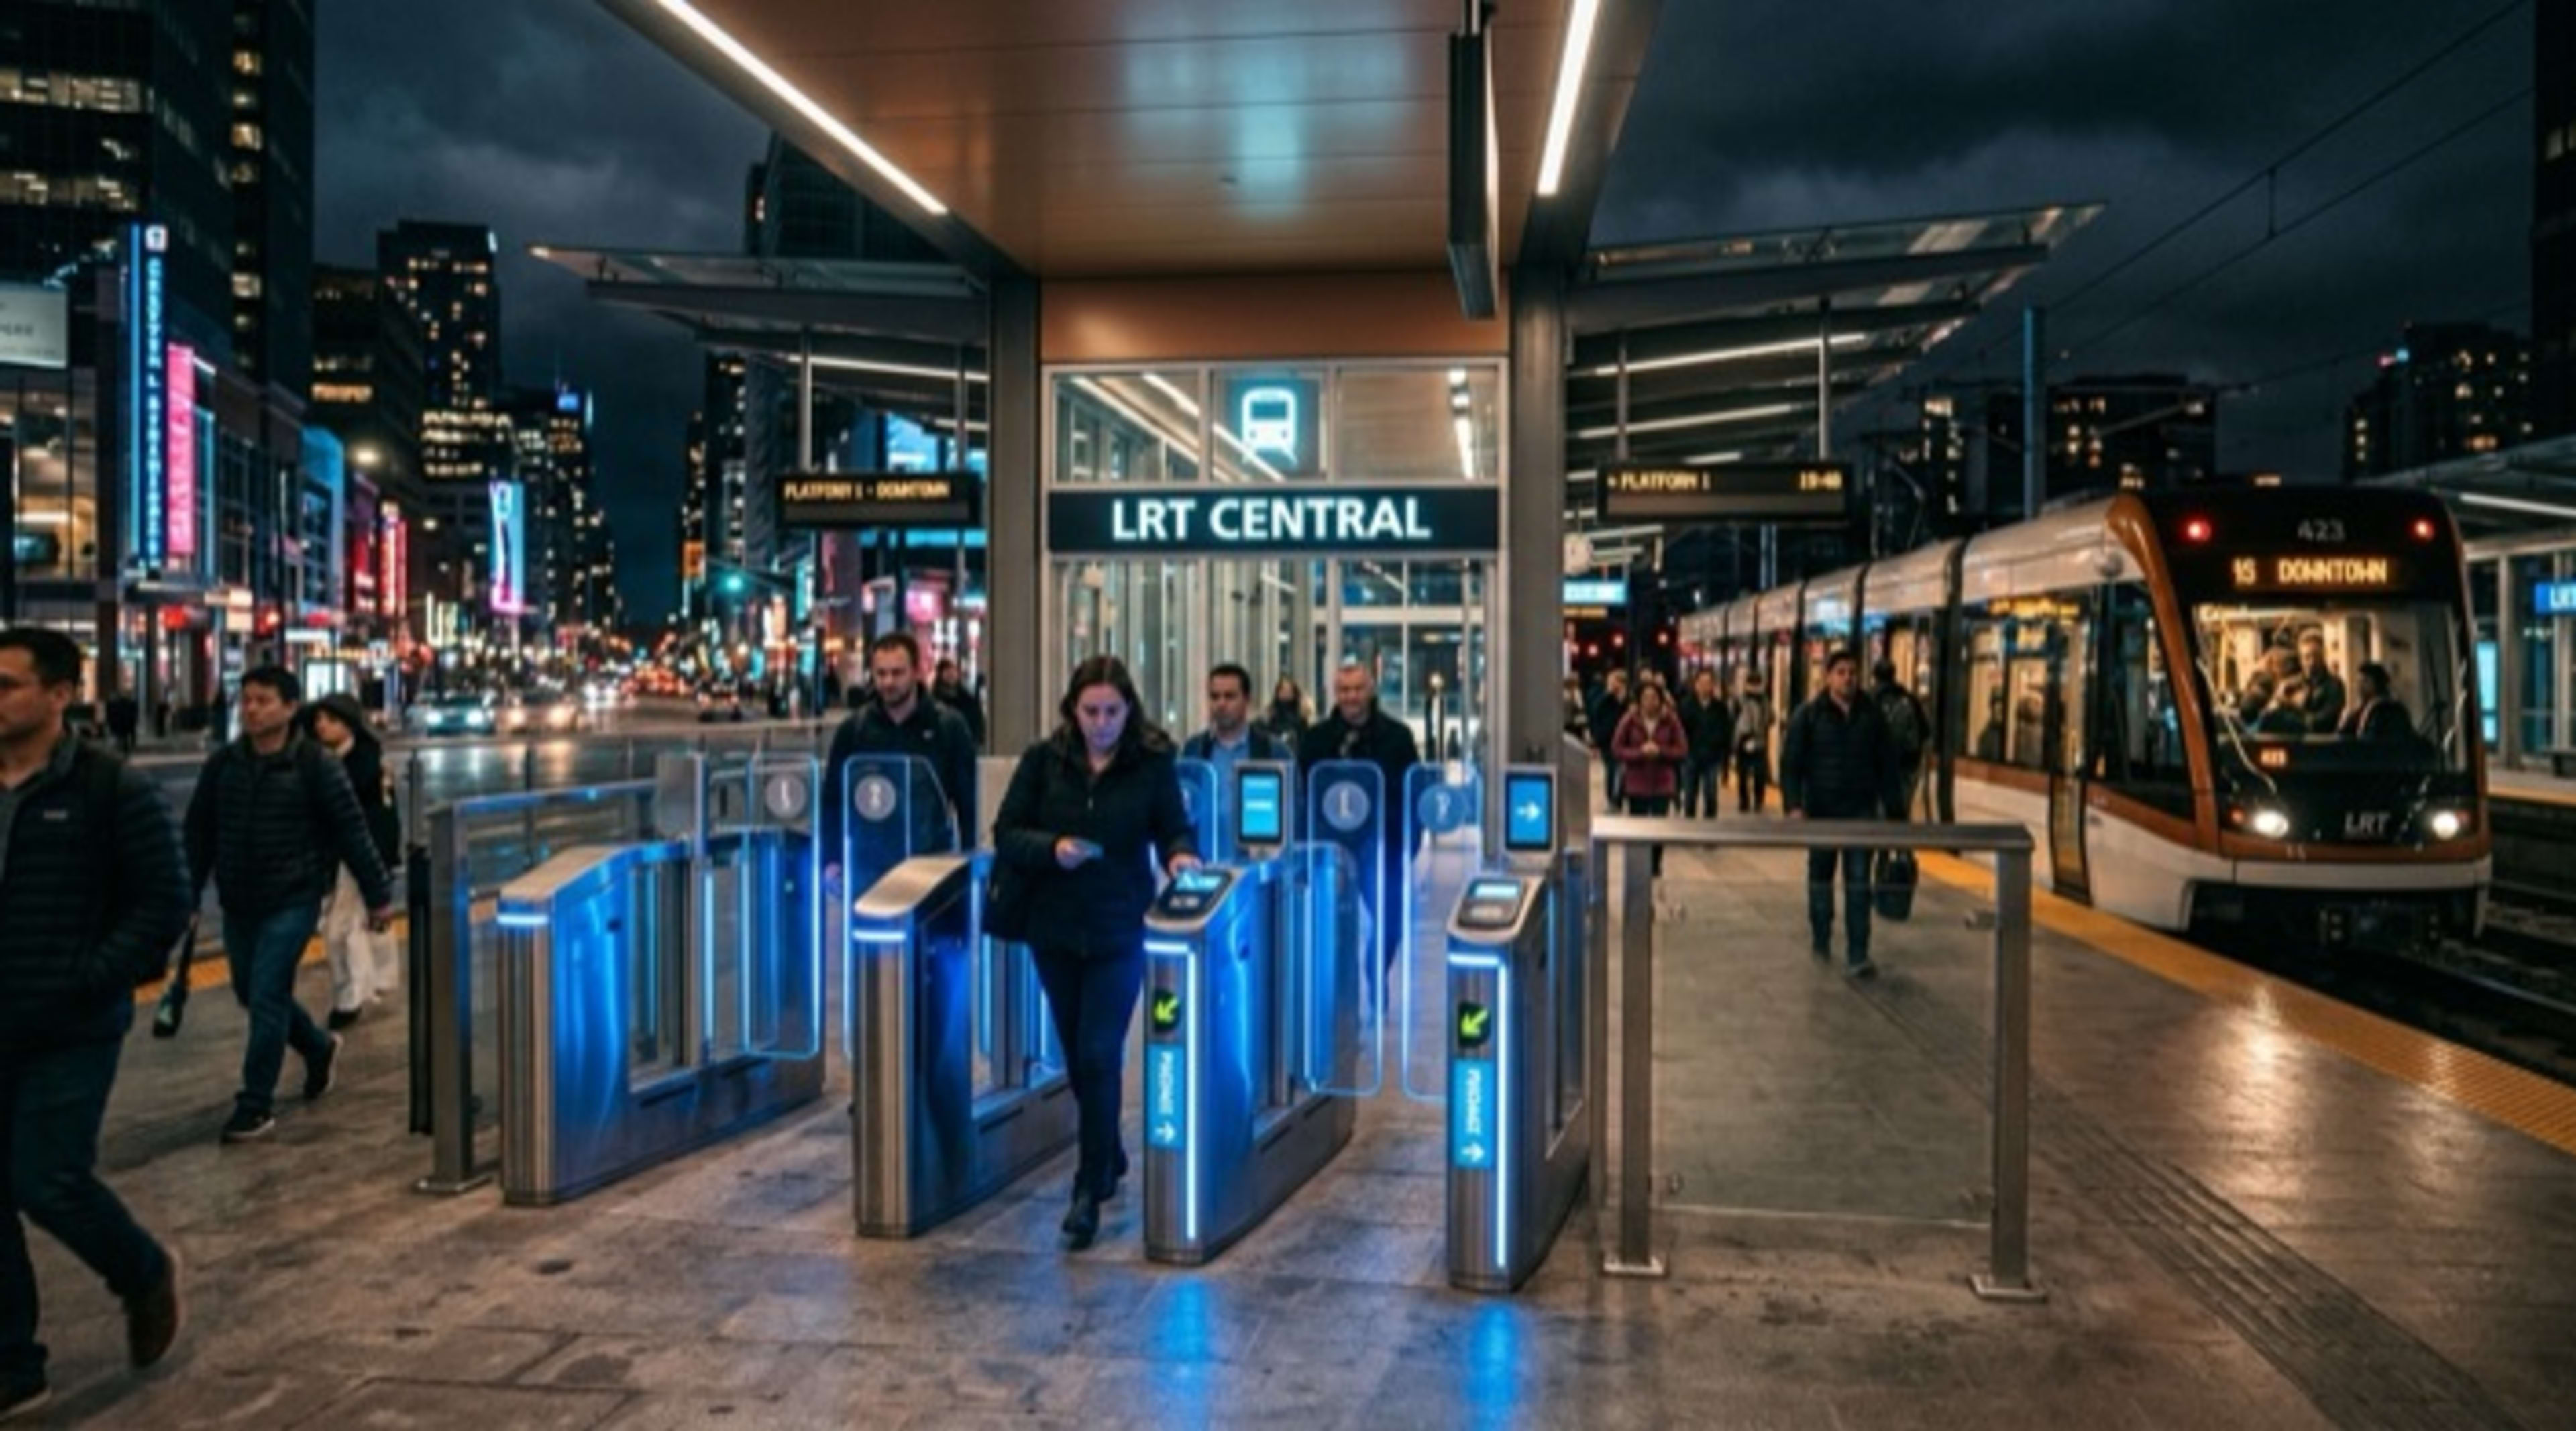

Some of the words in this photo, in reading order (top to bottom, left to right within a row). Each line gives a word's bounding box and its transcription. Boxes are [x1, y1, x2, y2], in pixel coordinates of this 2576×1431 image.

[1112, 497, 1196, 540] LRT
[1209, 496, 1432, 540] CENTRAL
[2297, 519, 2345, 542] 423
[2278, 558, 2388, 584] DOWNTOWN
[2345, 812, 2390, 836] LRT
